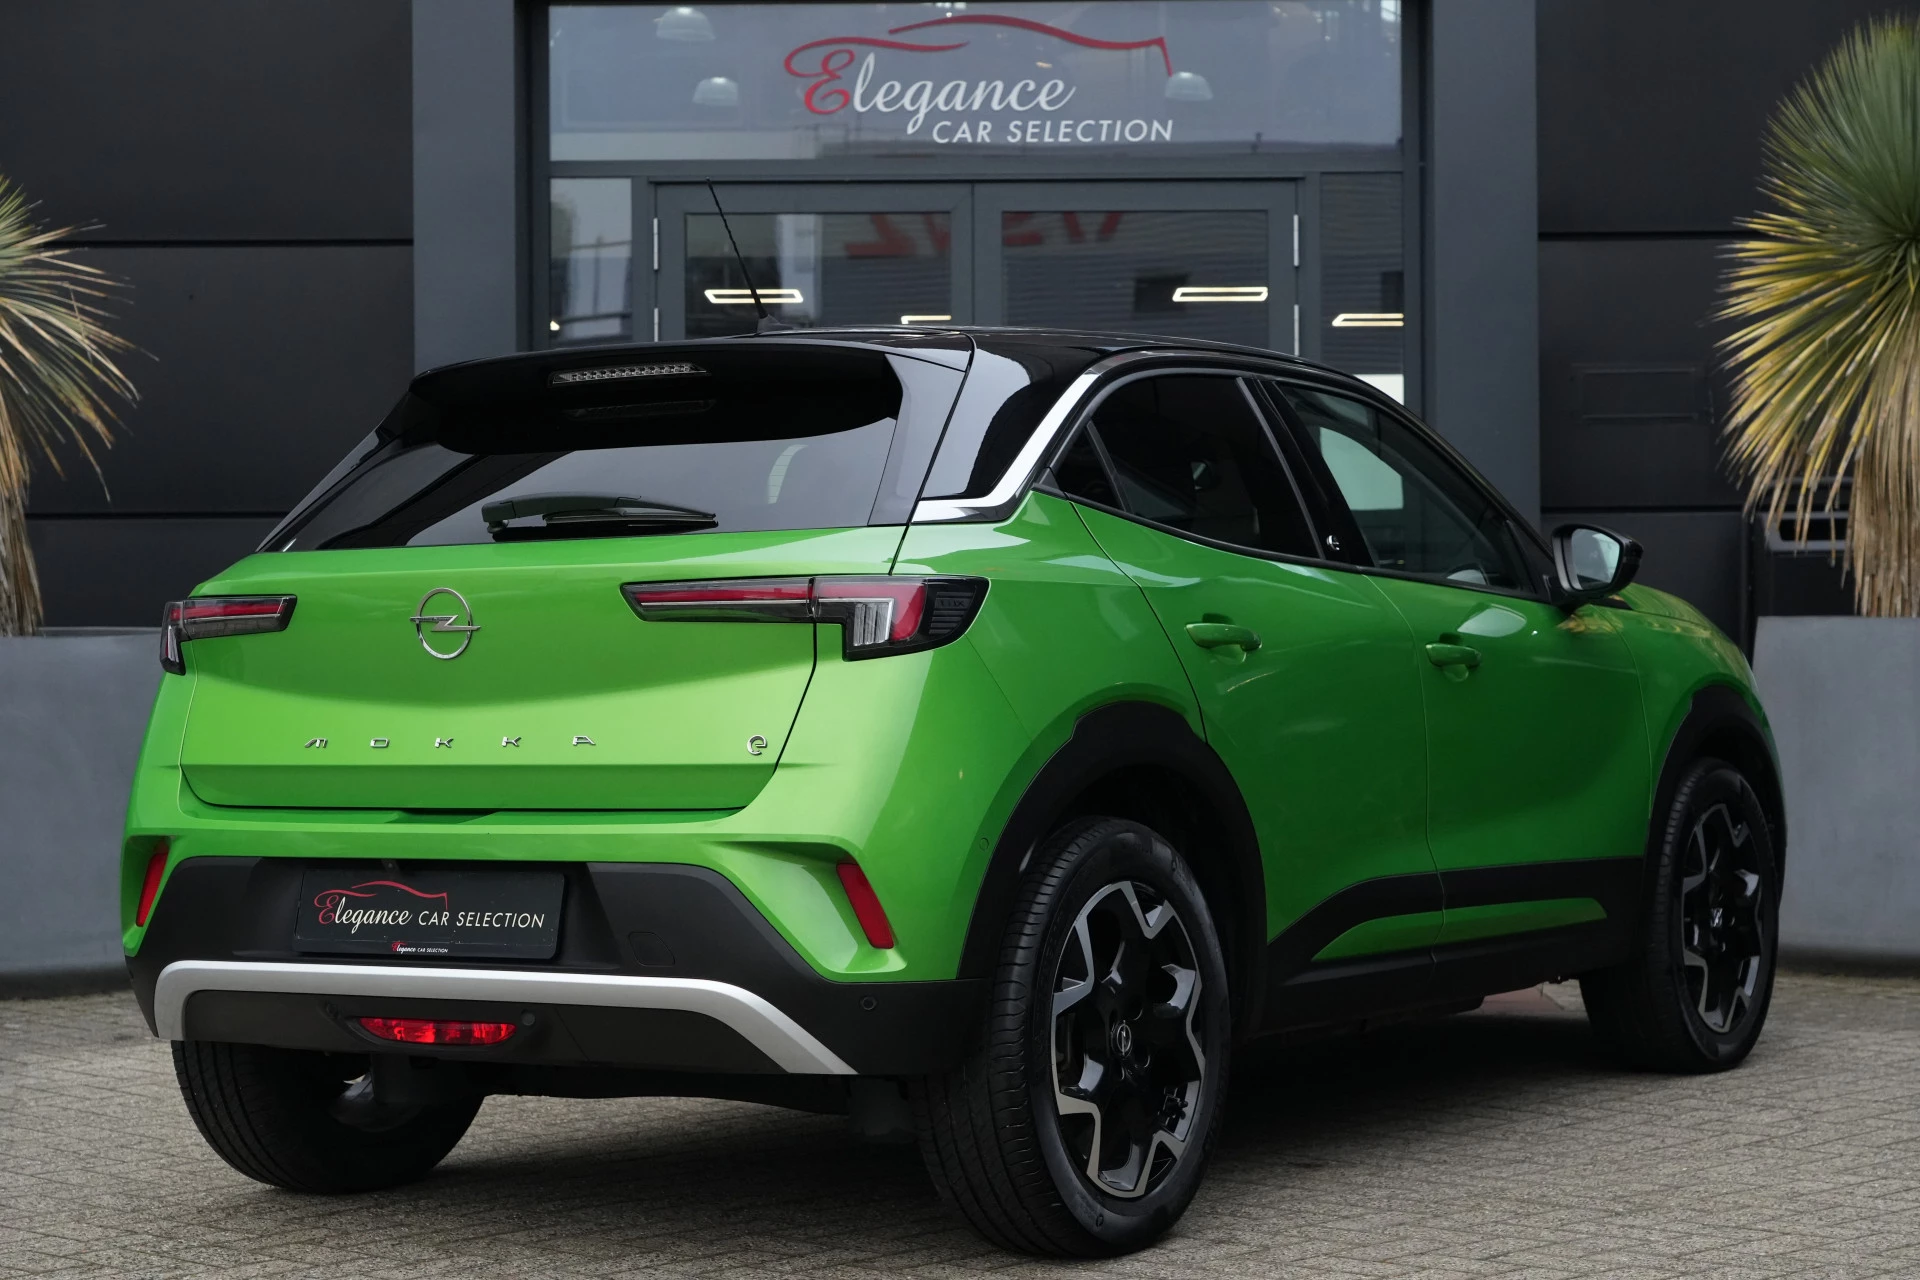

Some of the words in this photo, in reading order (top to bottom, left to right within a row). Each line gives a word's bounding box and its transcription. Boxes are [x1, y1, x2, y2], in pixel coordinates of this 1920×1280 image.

[784, 46, 1076, 135] Elegance
[932, 120, 992, 144] CAR
[1006, 118, 1174, 143] SELECTION
[314, 894, 413, 934] Elegance
[418, 910, 450, 926] CAR
[456, 911, 545, 929] SELECTION
